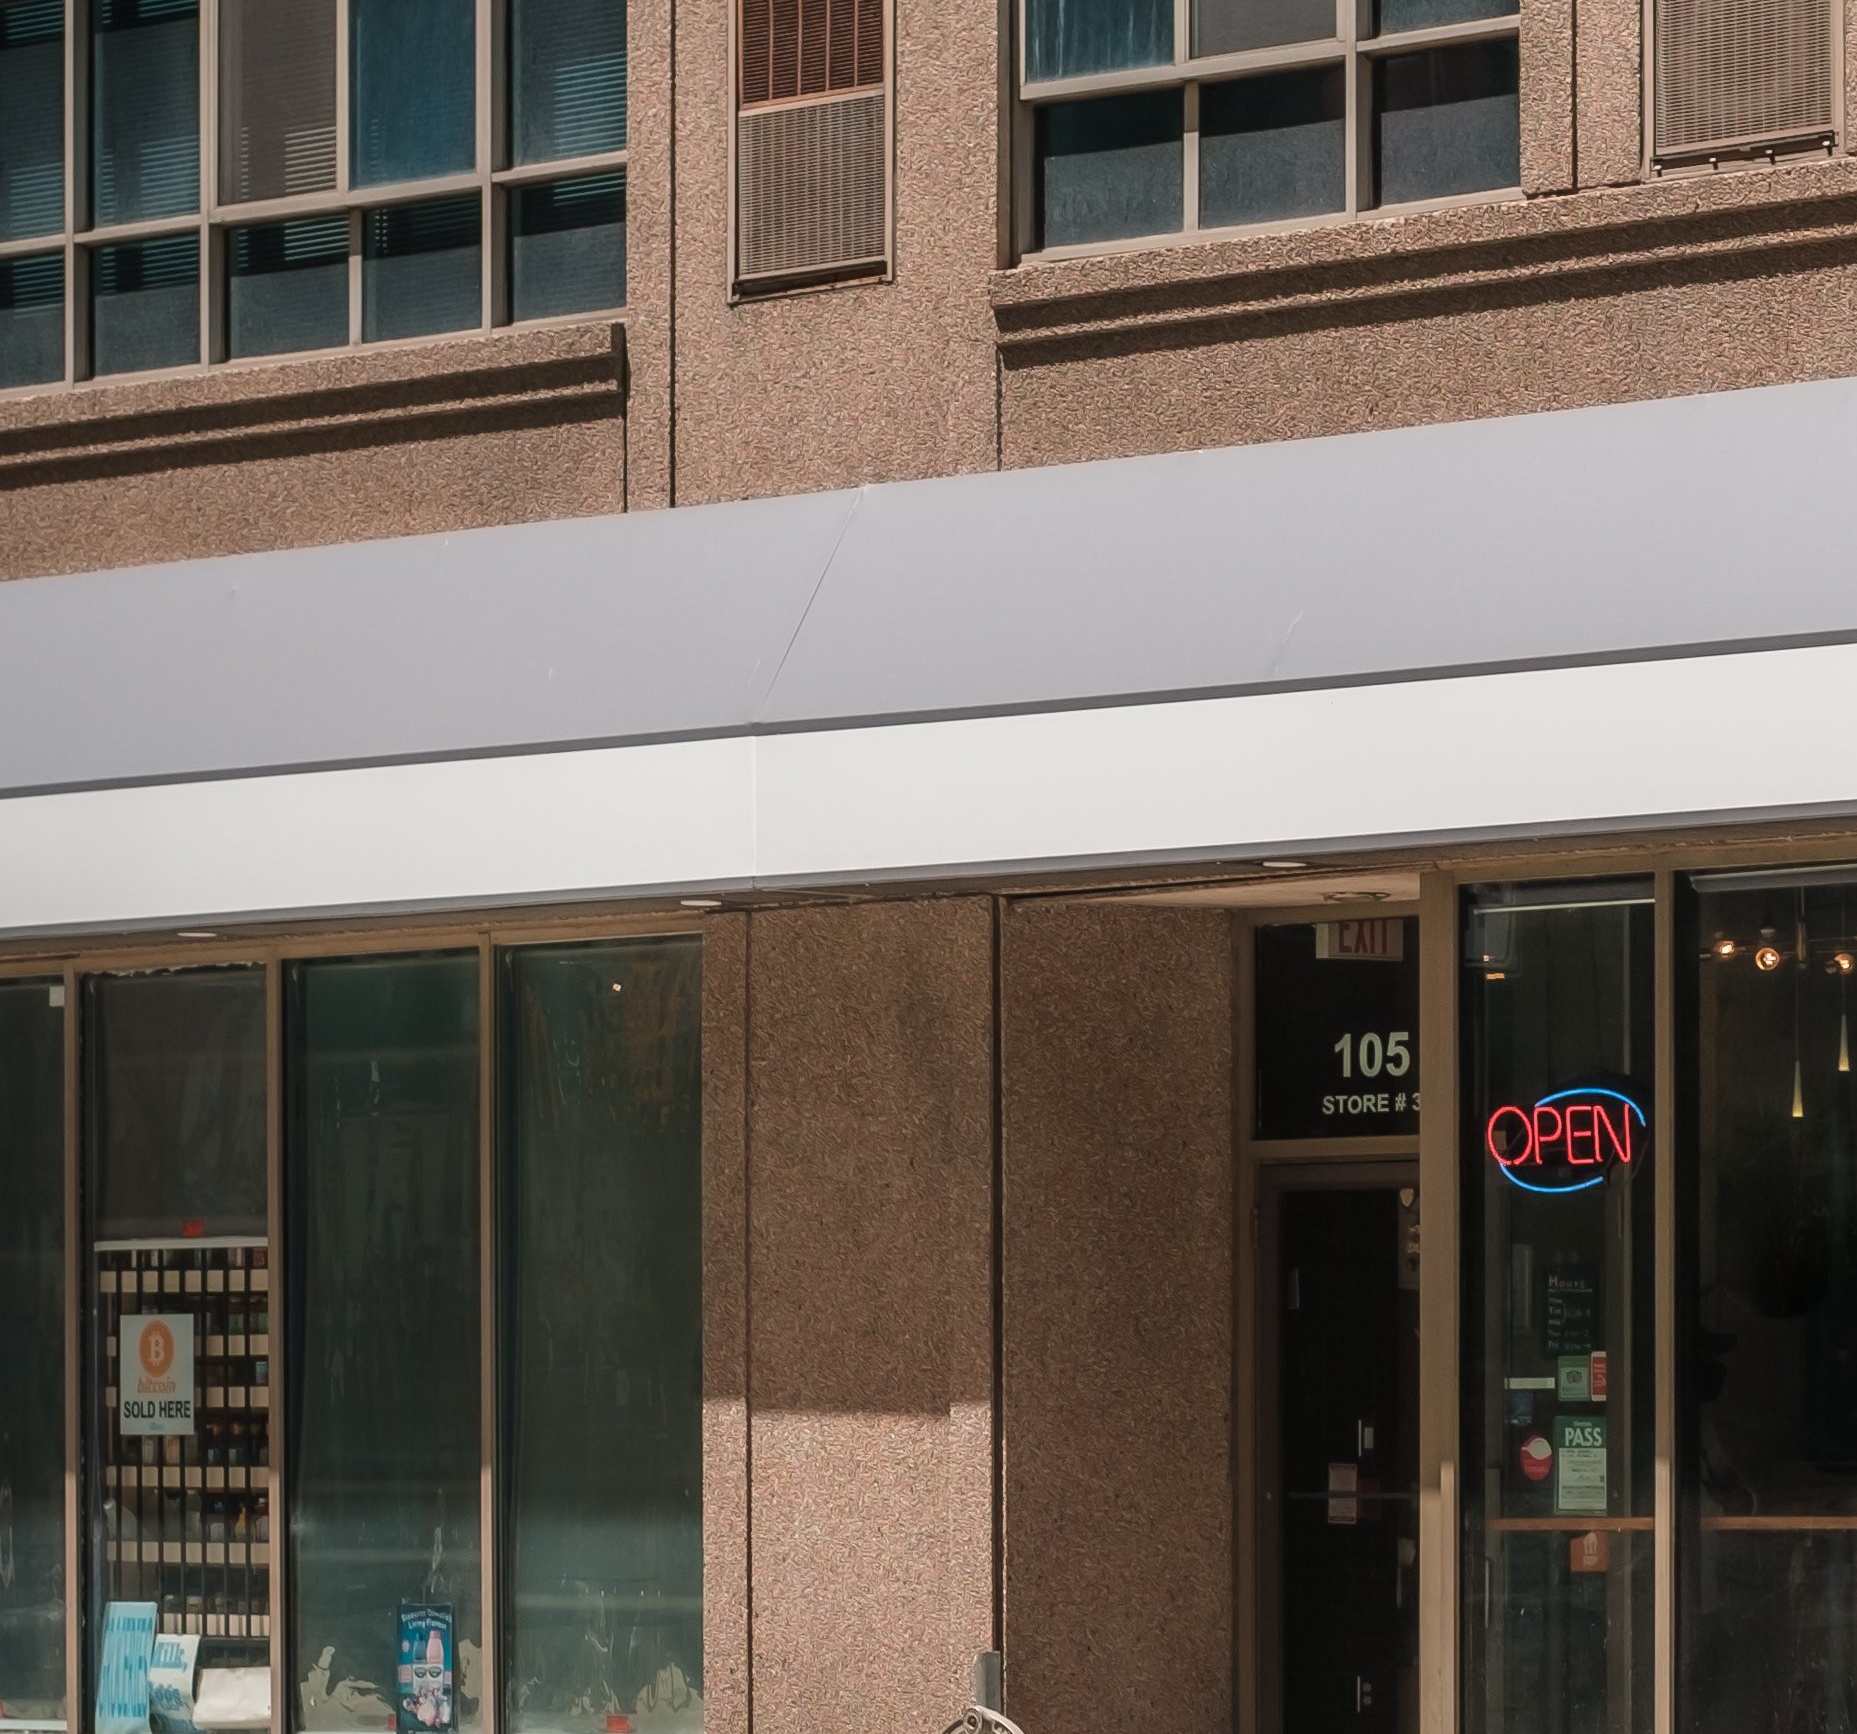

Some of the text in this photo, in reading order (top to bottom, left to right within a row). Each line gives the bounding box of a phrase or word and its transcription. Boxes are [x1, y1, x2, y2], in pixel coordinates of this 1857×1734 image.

[1334, 1032, 1411, 1078] 105
[1322, 1093, 1390, 1115] STORE
[1487, 1103, 1631, 1166] OPEN
[124, 1400, 191, 1418] SOLD HERE
[1565, 1427, 1602, 1446] PASS
